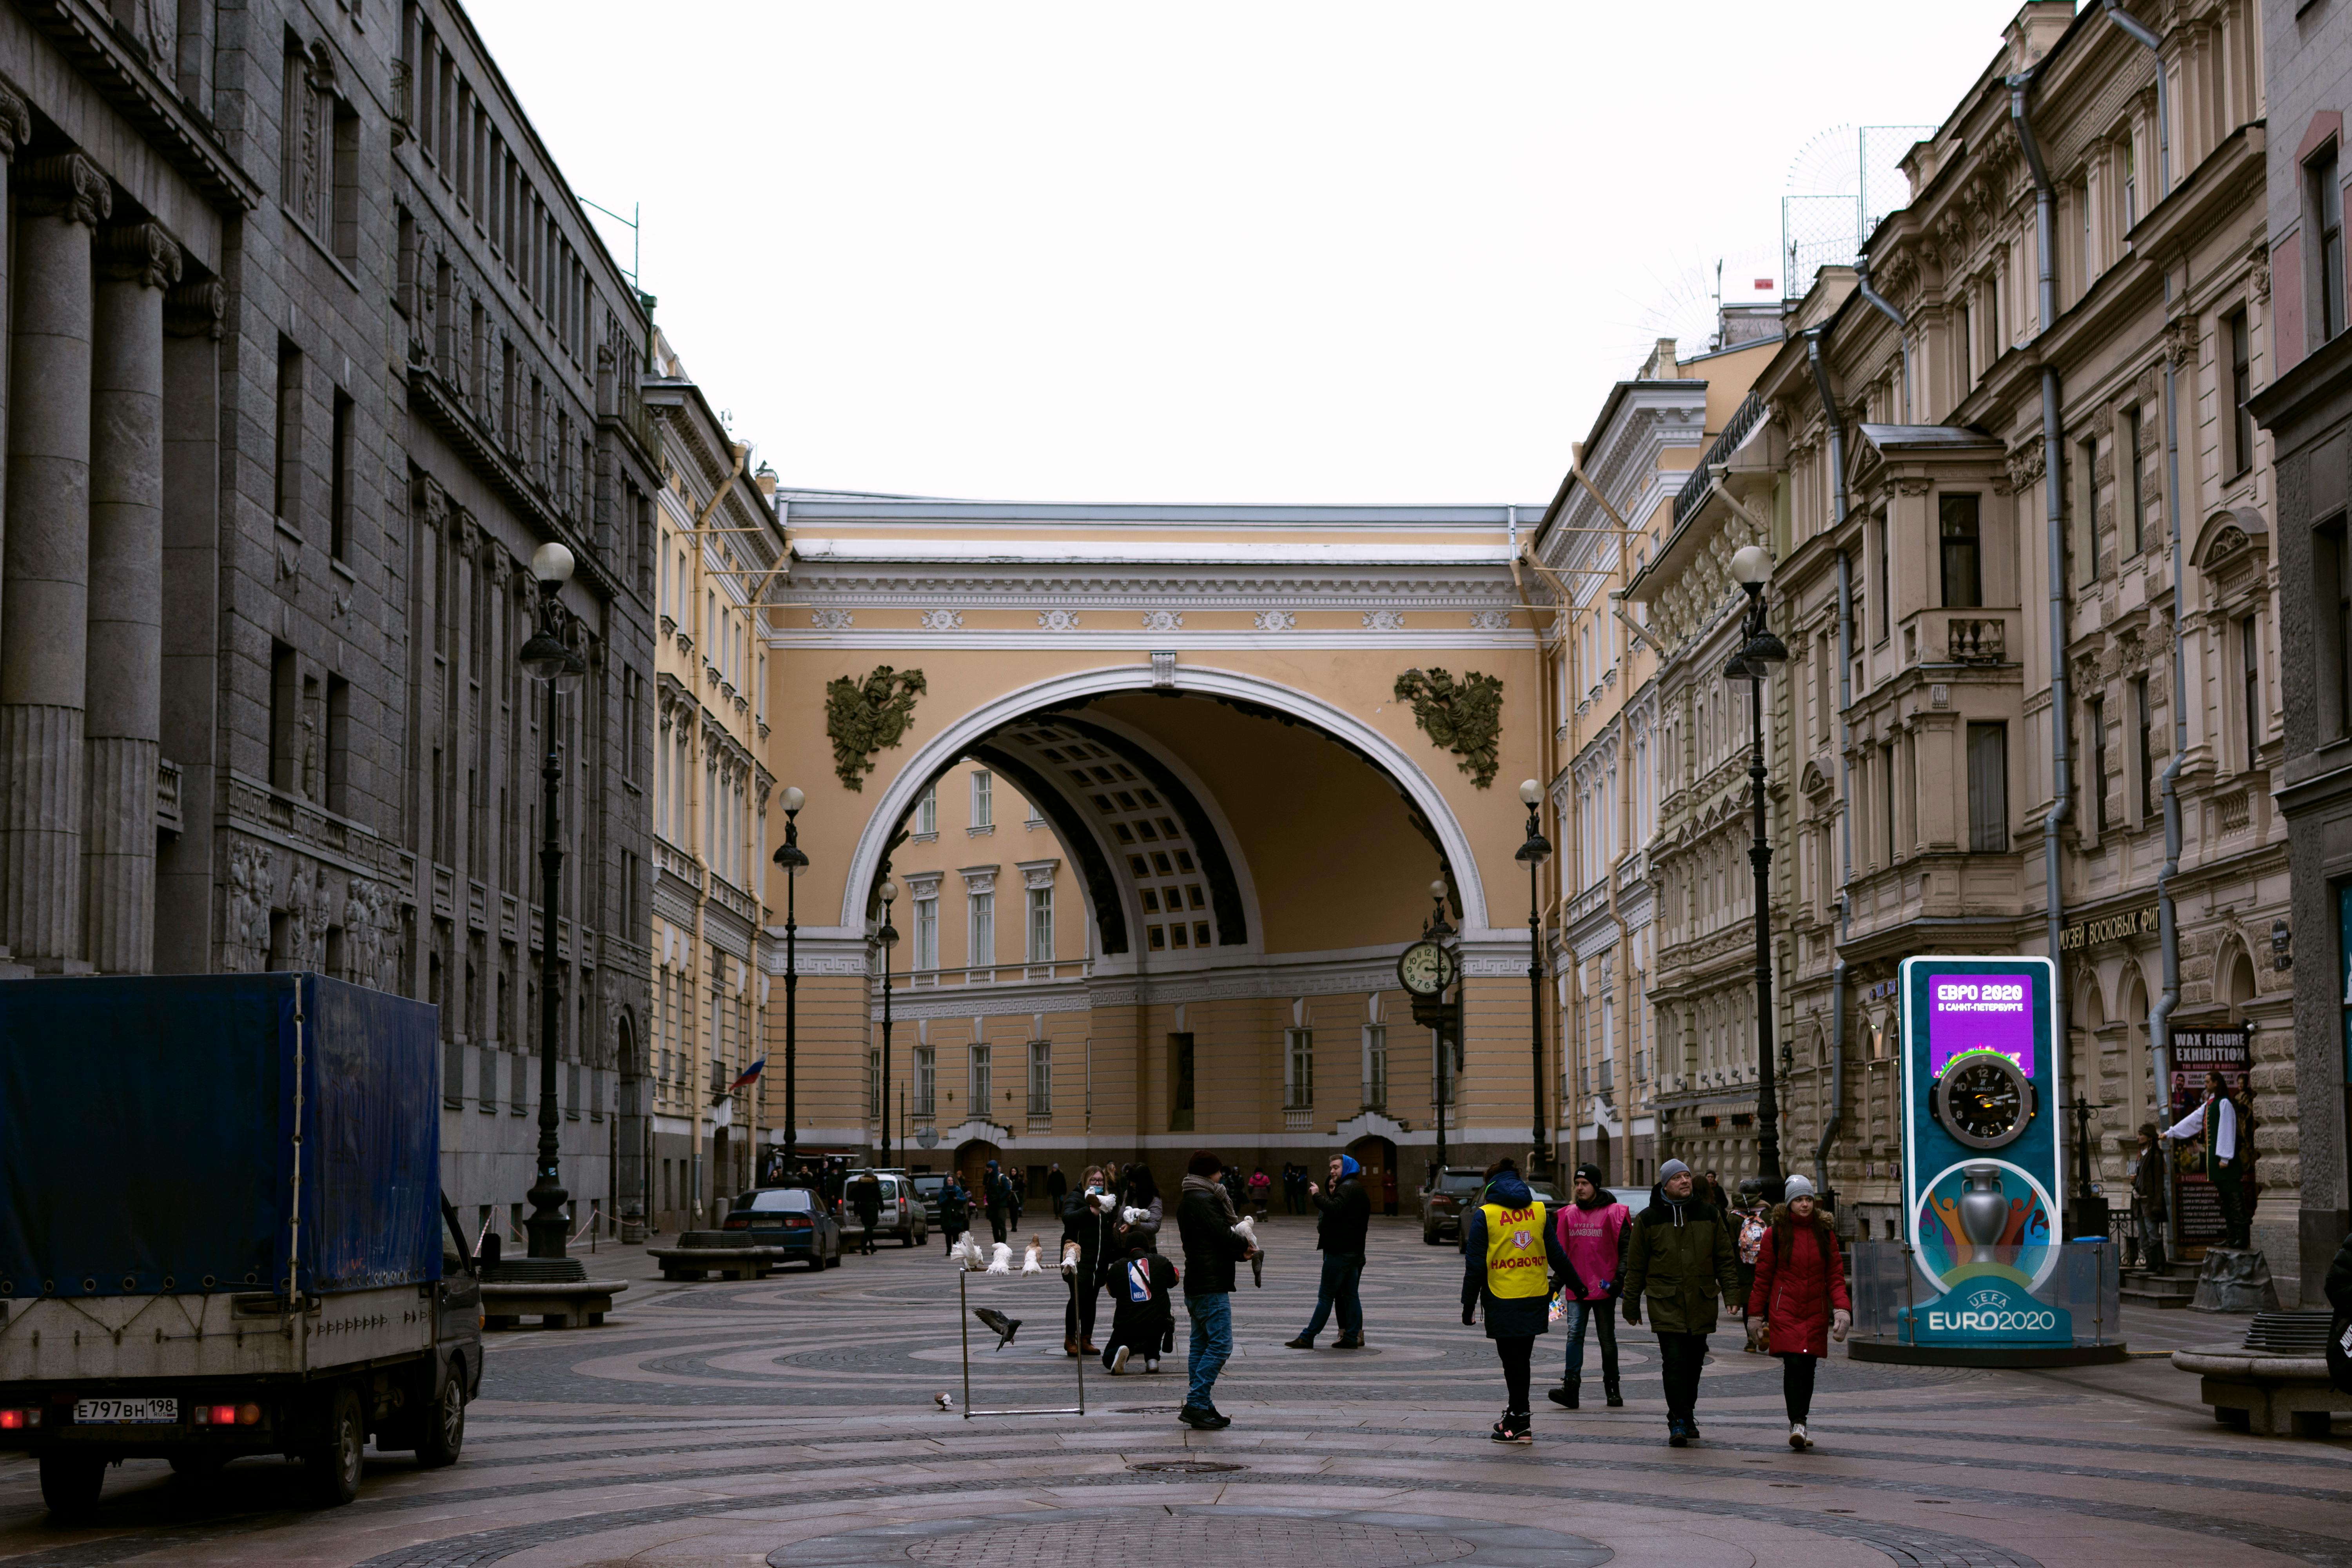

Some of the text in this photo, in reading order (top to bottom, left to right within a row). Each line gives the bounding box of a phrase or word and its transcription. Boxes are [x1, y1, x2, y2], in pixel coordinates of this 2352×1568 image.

[2059, 906, 2160, 951] МУЗЕЙ ВОСКОВЫХ ФИГ
[1938, 985, 2022, 1000] ЕВРО 2020
[1938, 1003, 2023, 1011] В САНКТ-ПЕТЕРБУРГЕ
[2174, 1033, 2245, 1047] WAX FIGURE
[2176, 1047, 2245, 1062] EXHIBITION
[1977, 1069, 1988, 1077] 12
[1955, 1083, 1967, 1091] 10
[1956, 1111, 1963, 1119] 8
[2006, 1110, 2012, 1118] 4
[1982, 1126, 1988, 1134] 6
[1500, 1209, 1535, 1226] ДОМ
[1969, 1293, 2007, 1307] UEFA
[148, 1400, 173, 1412] 198
